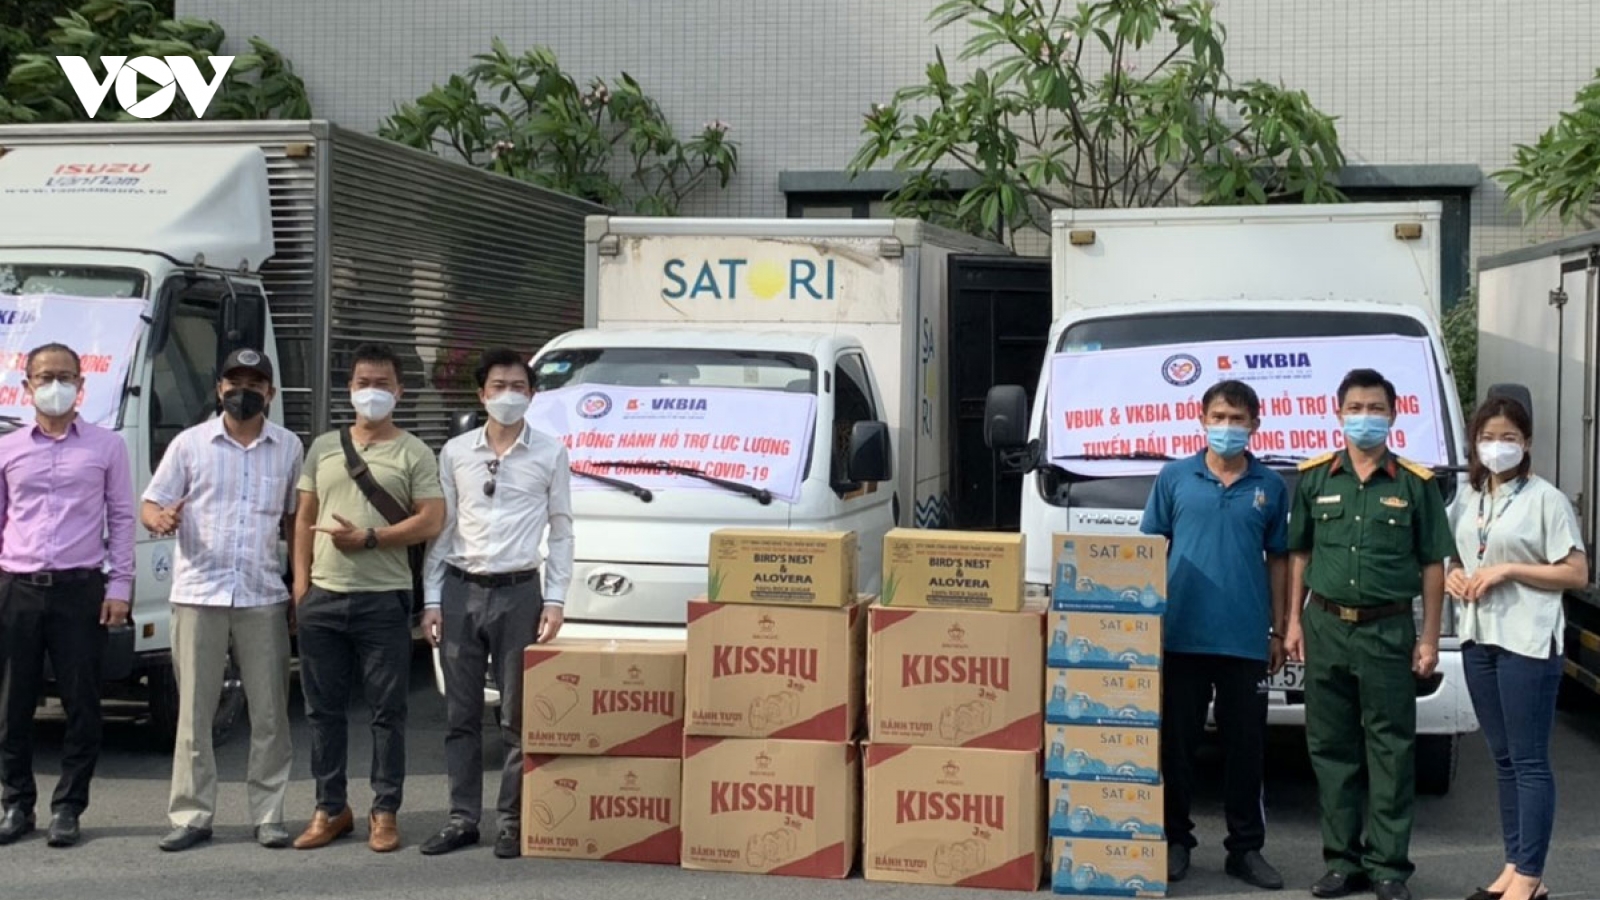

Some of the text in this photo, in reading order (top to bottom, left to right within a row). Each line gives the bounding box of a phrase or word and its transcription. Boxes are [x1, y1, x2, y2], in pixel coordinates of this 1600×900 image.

[54, 163, 151, 175] ISUZU
[1244, 352, 1312, 369] VKBIA
[652, 398, 707, 411] VKBIA
[1065, 406, 1105, 430] VBUK
[1109, 407, 1121, 425] &
[1125, 401, 1172, 424] VKBIA
[1296, 395, 1327, 419] TRỢ
[683, 432, 710, 452] TRỢ
[743, 436, 791, 458] LƯỢNG
[1290, 430, 1328, 453] DỊCH
[703, 461, 770, 481] COVID-19
[754, 553, 814, 565] BIRD'S NEST
[1089, 544, 1153, 559] SATORI
[779, 564, 787, 573] &
[929, 557, 992, 569] BIRD'S NEST
[753, 574, 813, 584] ALOVERA
[955, 568, 964, 578] &
[928, 577, 990, 588] ALOVERA
[712, 645, 818, 683] KISSHU
[902, 654, 1010, 692] KISSHU
[592, 689, 675, 717] KISSHU
[710, 780, 815, 820] KISSHU
[589, 795, 671, 824] KISSHU
[896, 790, 1005, 831] KISSHU
